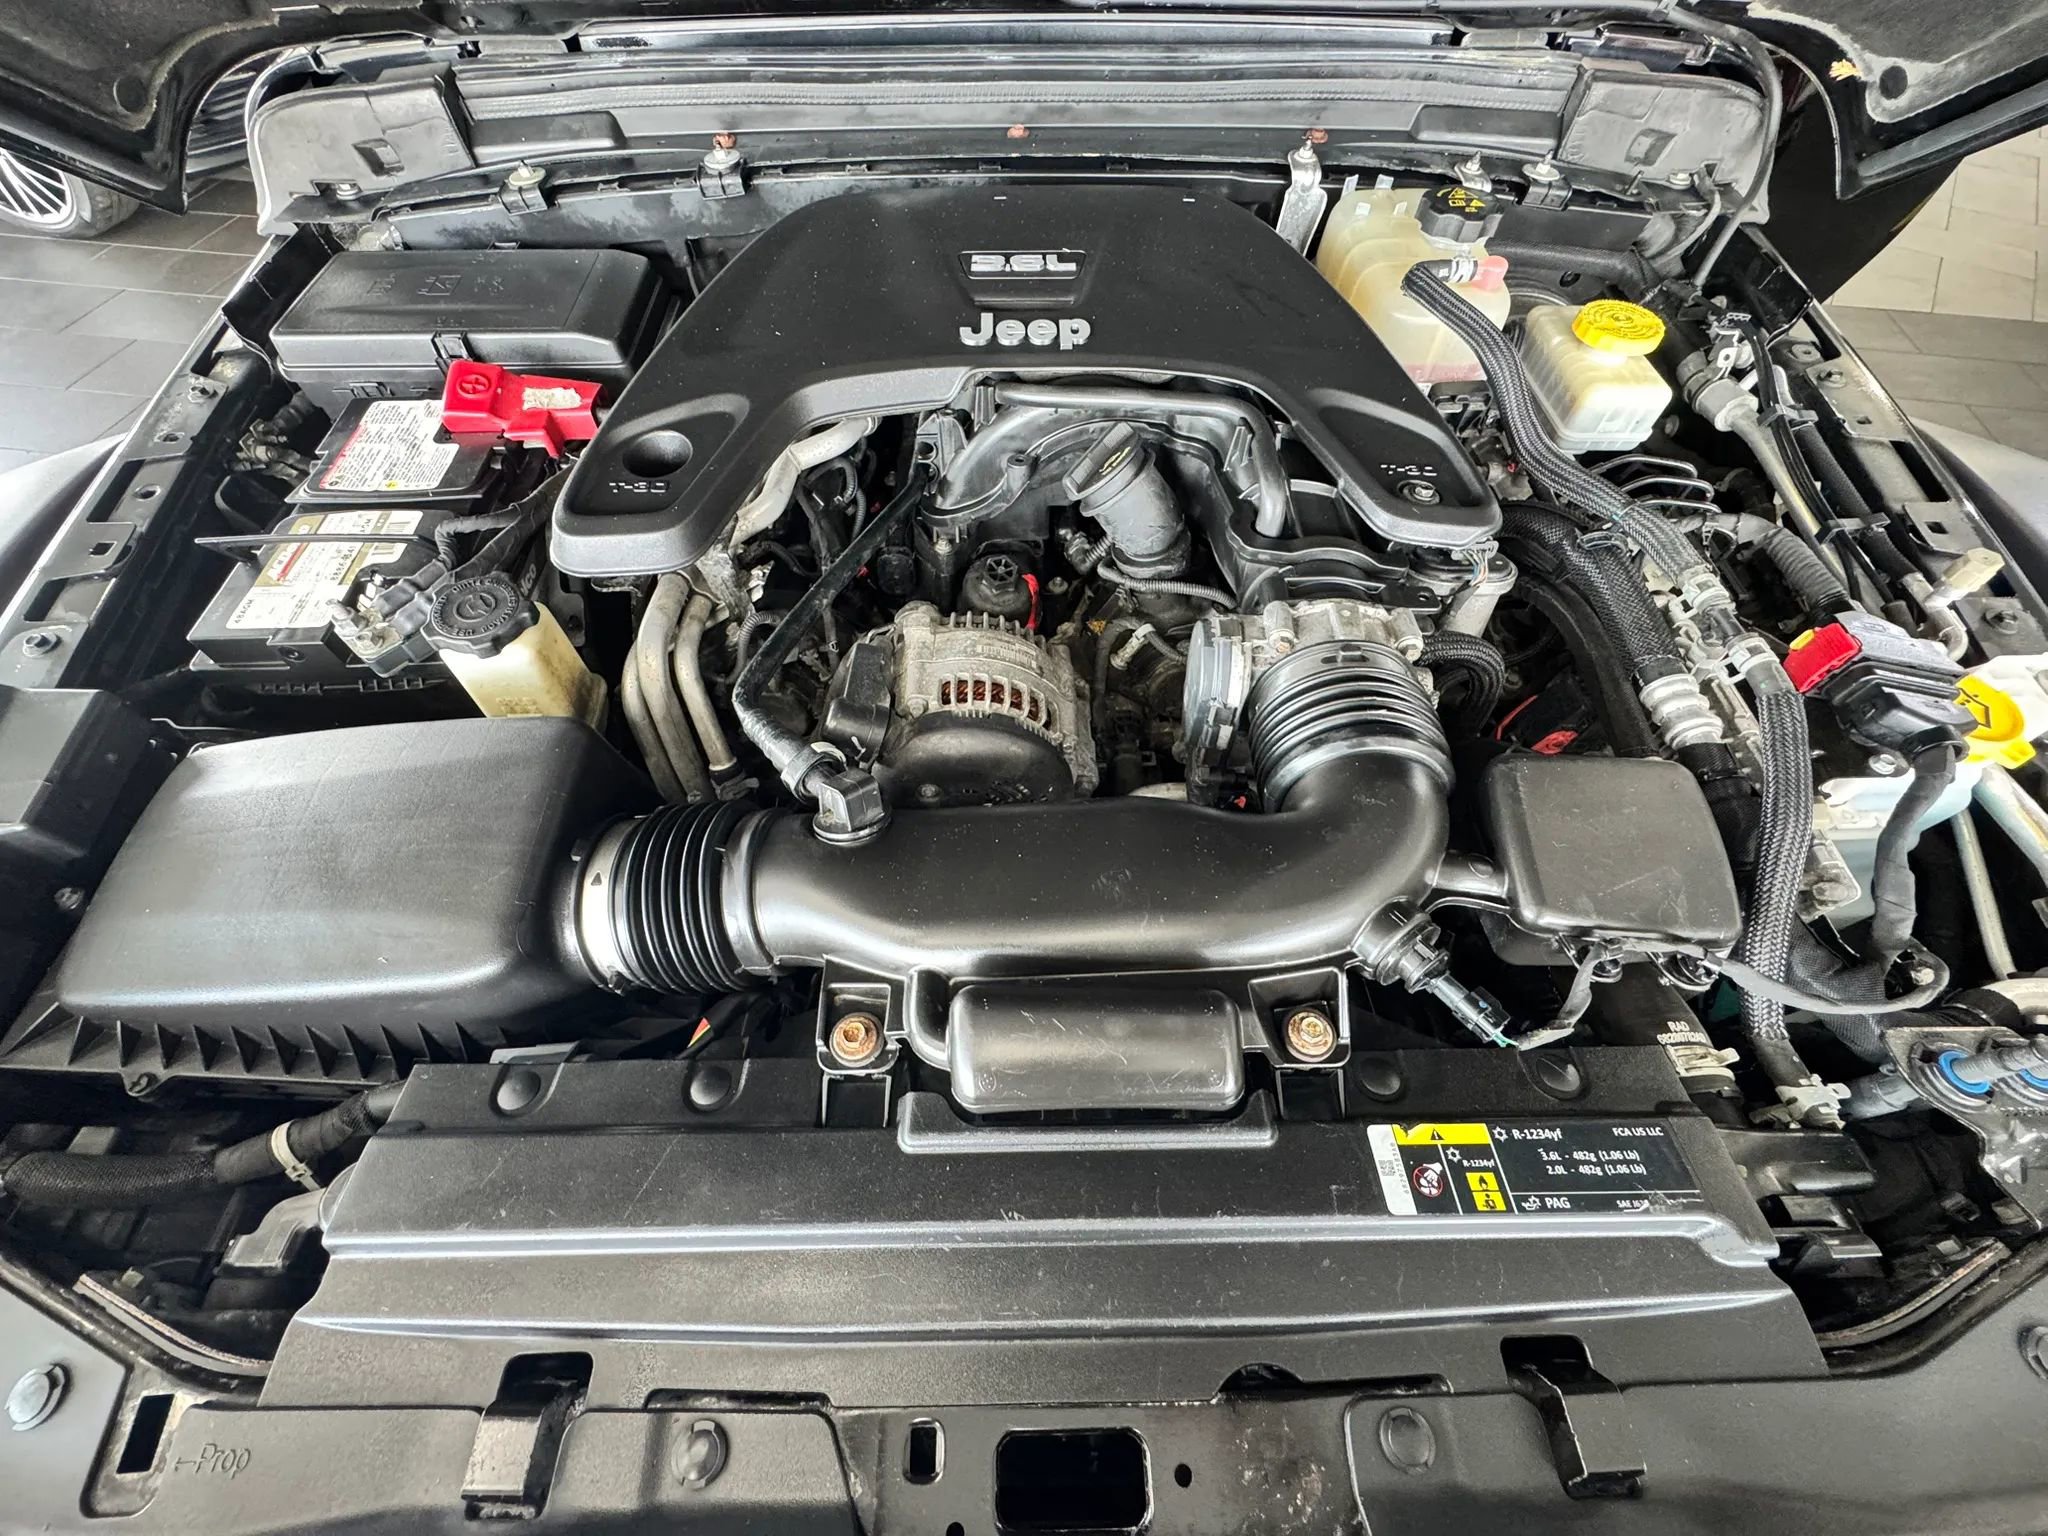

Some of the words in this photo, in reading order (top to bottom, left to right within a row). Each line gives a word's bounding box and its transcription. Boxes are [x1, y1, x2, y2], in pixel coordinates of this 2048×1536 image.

[970, 254, 1077, 272] 3.6L
[959, 312, 1091, 351] Jeep
[1667, 1021, 1690, 1032] RAD
[1512, 1128, 1563, 1142] R-1234yf
[1613, 1127, 1632, 1137] FCA
[1633, 1127, 1645, 1136] US
[1646, 1127, 1664, 1137] LLC
[1541, 1150, 1562, 1161] 3.6L
[1573, 1151, 1597, 1162] 482g
[1599, 1150, 1624, 1162] (1.06
[1625, 1150, 1640, 1162] Lb)
[1462, 1158, 1495, 1168] R-1234yf
[1546, 1165, 1568, 1175] 2.0L
[1578, 1165, 1603, 1177] 482g
[1605, 1164, 1630, 1177] (1.06
[1631, 1164, 1647, 1176] Lb)
[1545, 1197, 1571, 1209] PAG
[1616, 1200, 1632, 1208] SAE
[195, 1442, 252, 1480] Prop
